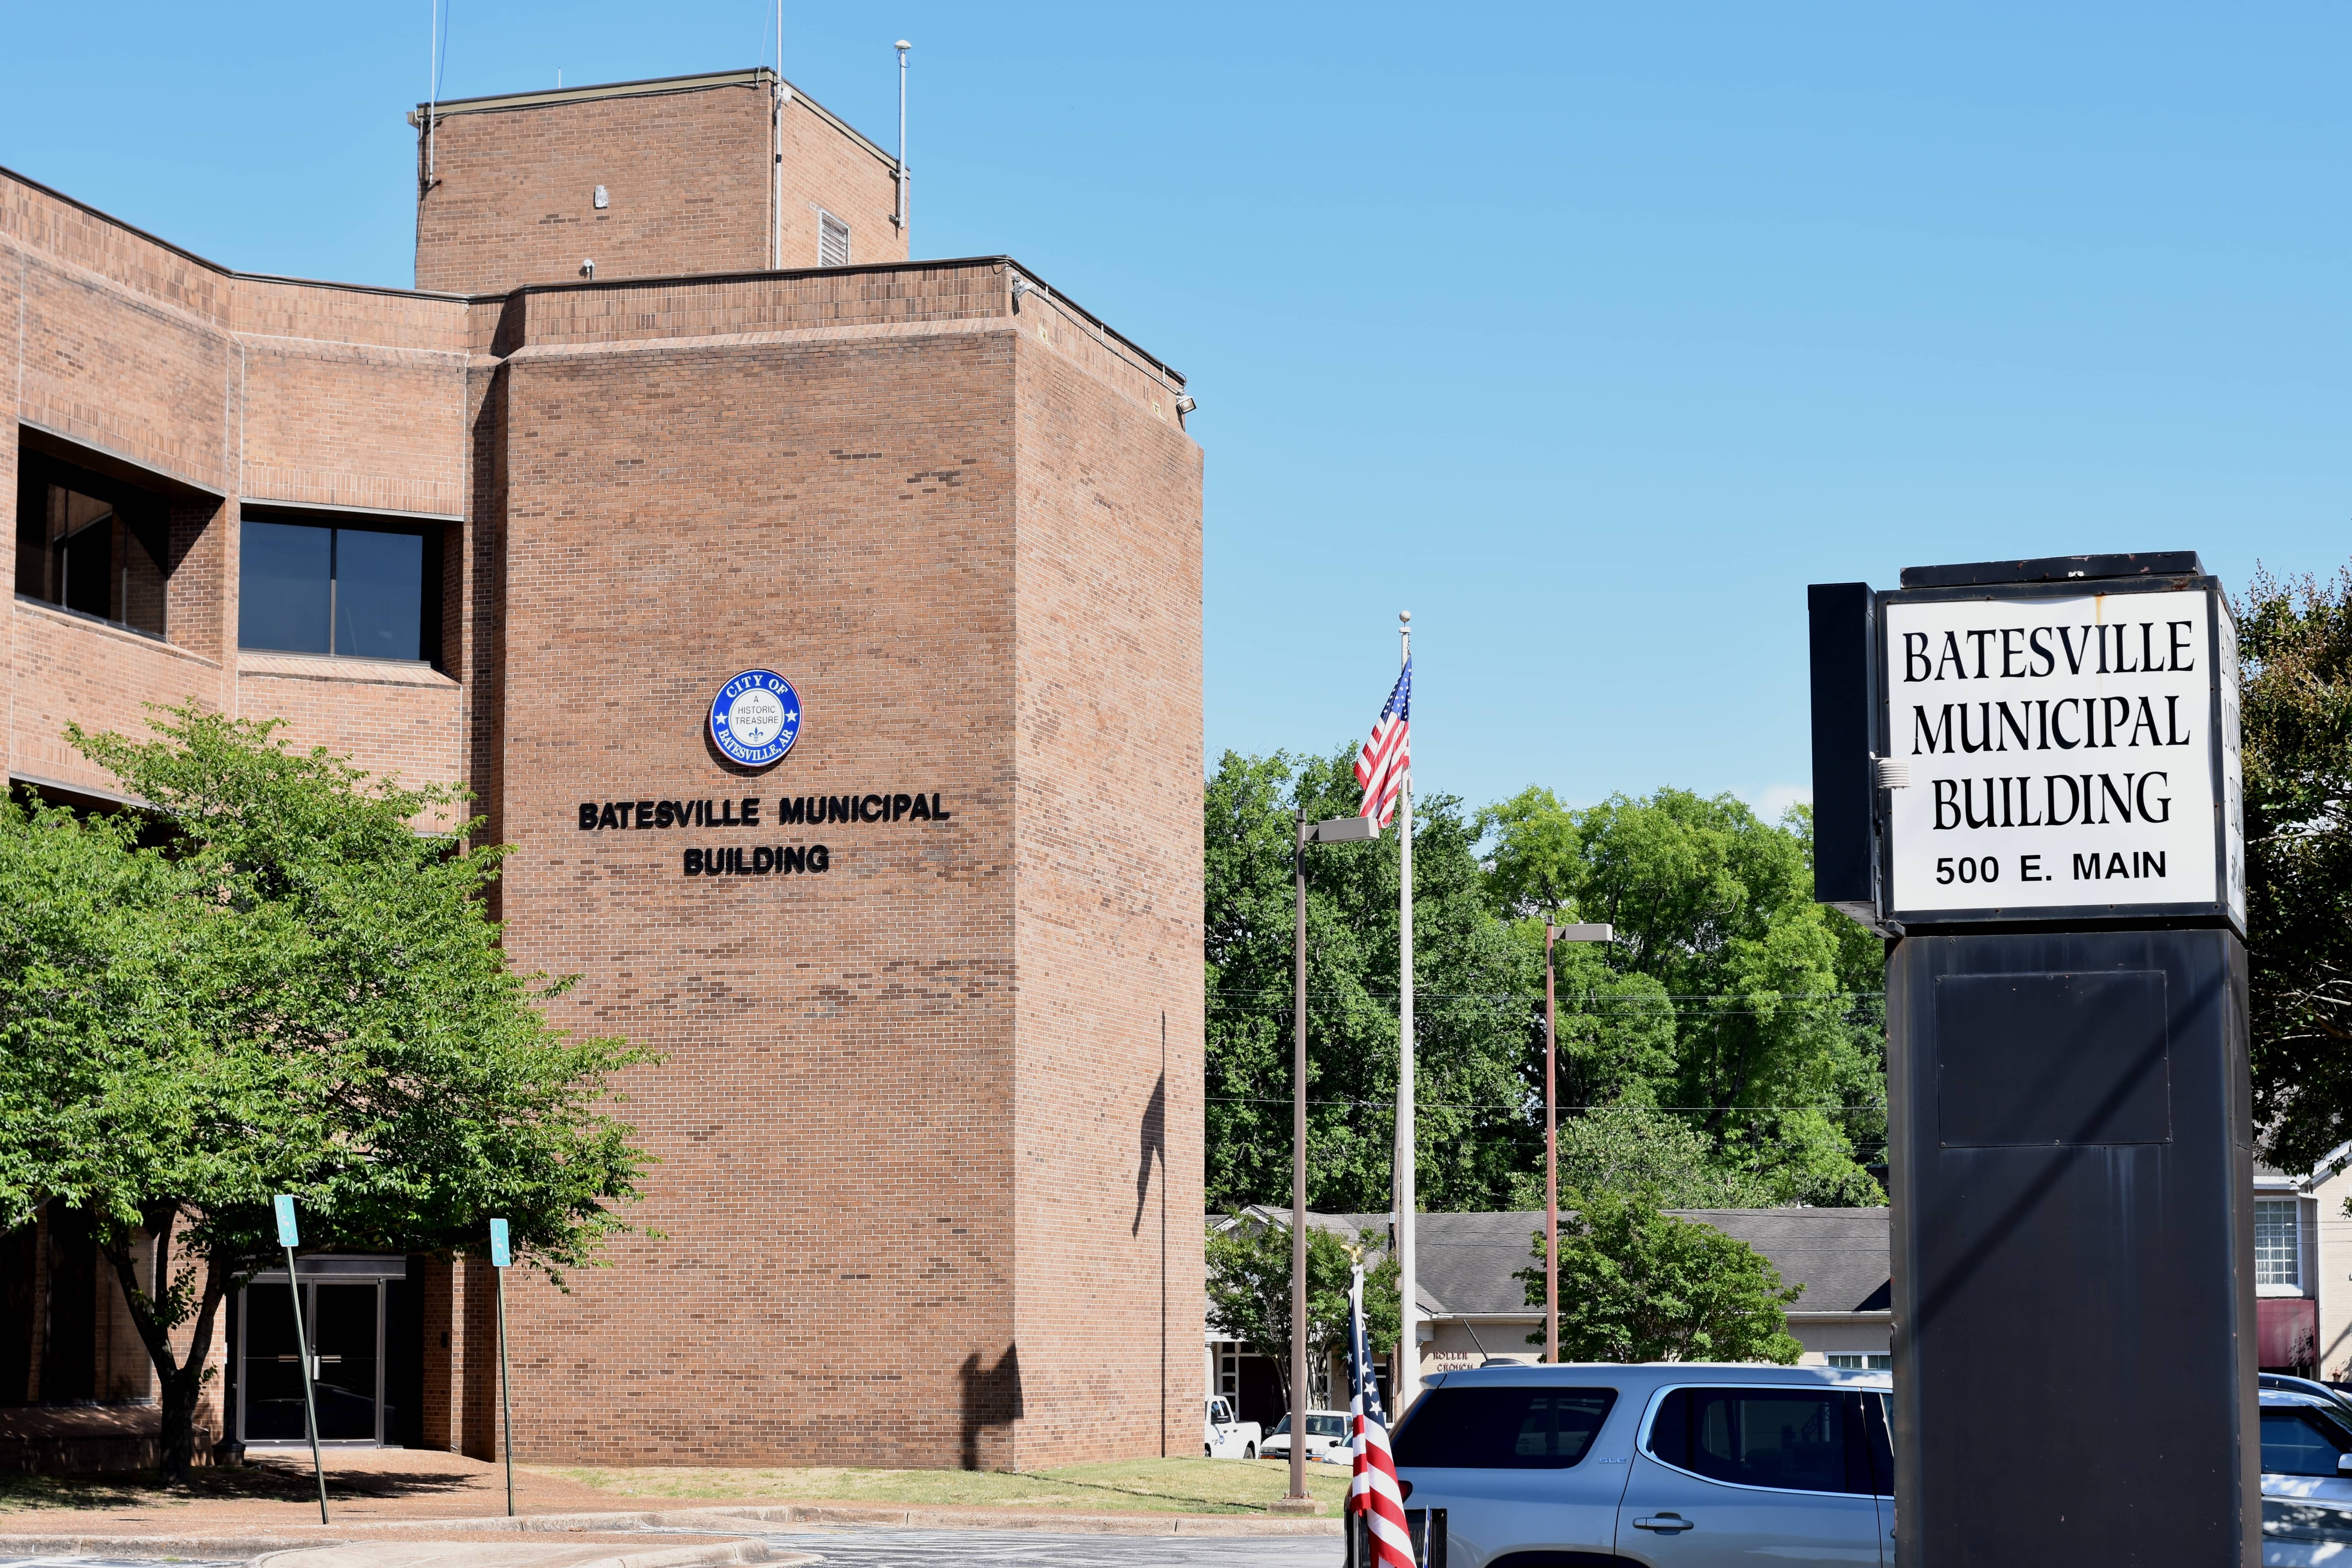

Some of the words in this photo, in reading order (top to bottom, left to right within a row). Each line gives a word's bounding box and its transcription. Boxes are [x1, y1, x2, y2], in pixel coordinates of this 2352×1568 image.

[1903, 621, 2194, 682] BATESVILLE
[726, 675, 763, 698] CITY
[768, 679, 789, 695] OF
[735, 716, 779, 725] TREASURE
[738, 706, 775, 714] HISTORIC
[1912, 696, 2190, 755] MUNICIPAL
[718, 728, 782, 760] BATESVILLE,
[779, 729, 794, 748] AR
[579, 799, 759, 830] BATESVILLE
[780, 793, 949, 825] MUNICIPAL
[1932, 771, 2171, 829] BUILDING
[684, 845, 829, 876] BUILDING
[1936, 857, 1998, 884] 500
[2021, 855, 2051, 881] E.
[2073, 851, 2165, 880] MAIN
[1433, 1351, 1468, 1360] ROLLER
